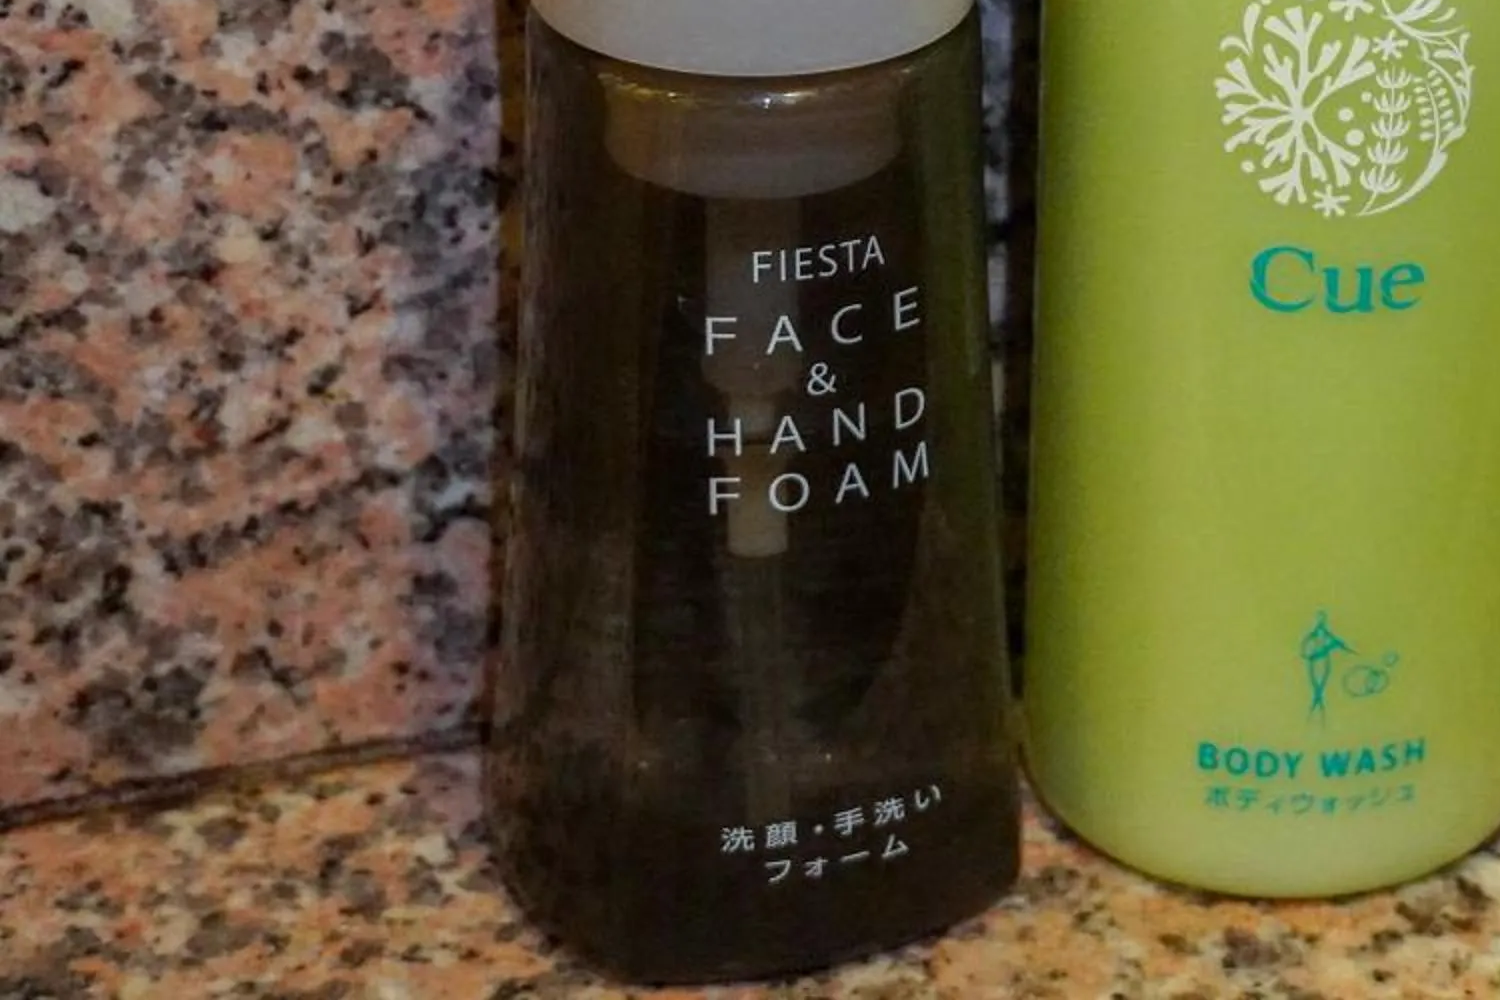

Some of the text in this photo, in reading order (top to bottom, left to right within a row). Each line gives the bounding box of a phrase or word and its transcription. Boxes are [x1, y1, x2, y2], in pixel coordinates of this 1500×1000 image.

[752, 235, 886, 284] FIESTA
[1250, 245, 1426, 314] Cue
[705, 286, 921, 356] FACE
[807, 362, 837, 396] &
[707, 387, 926, 457] HAND
[708, 440, 930, 516] FOAM
[1197, 736, 1426, 779] BODY WASH
[764, 833, 910, 884] フォーム
